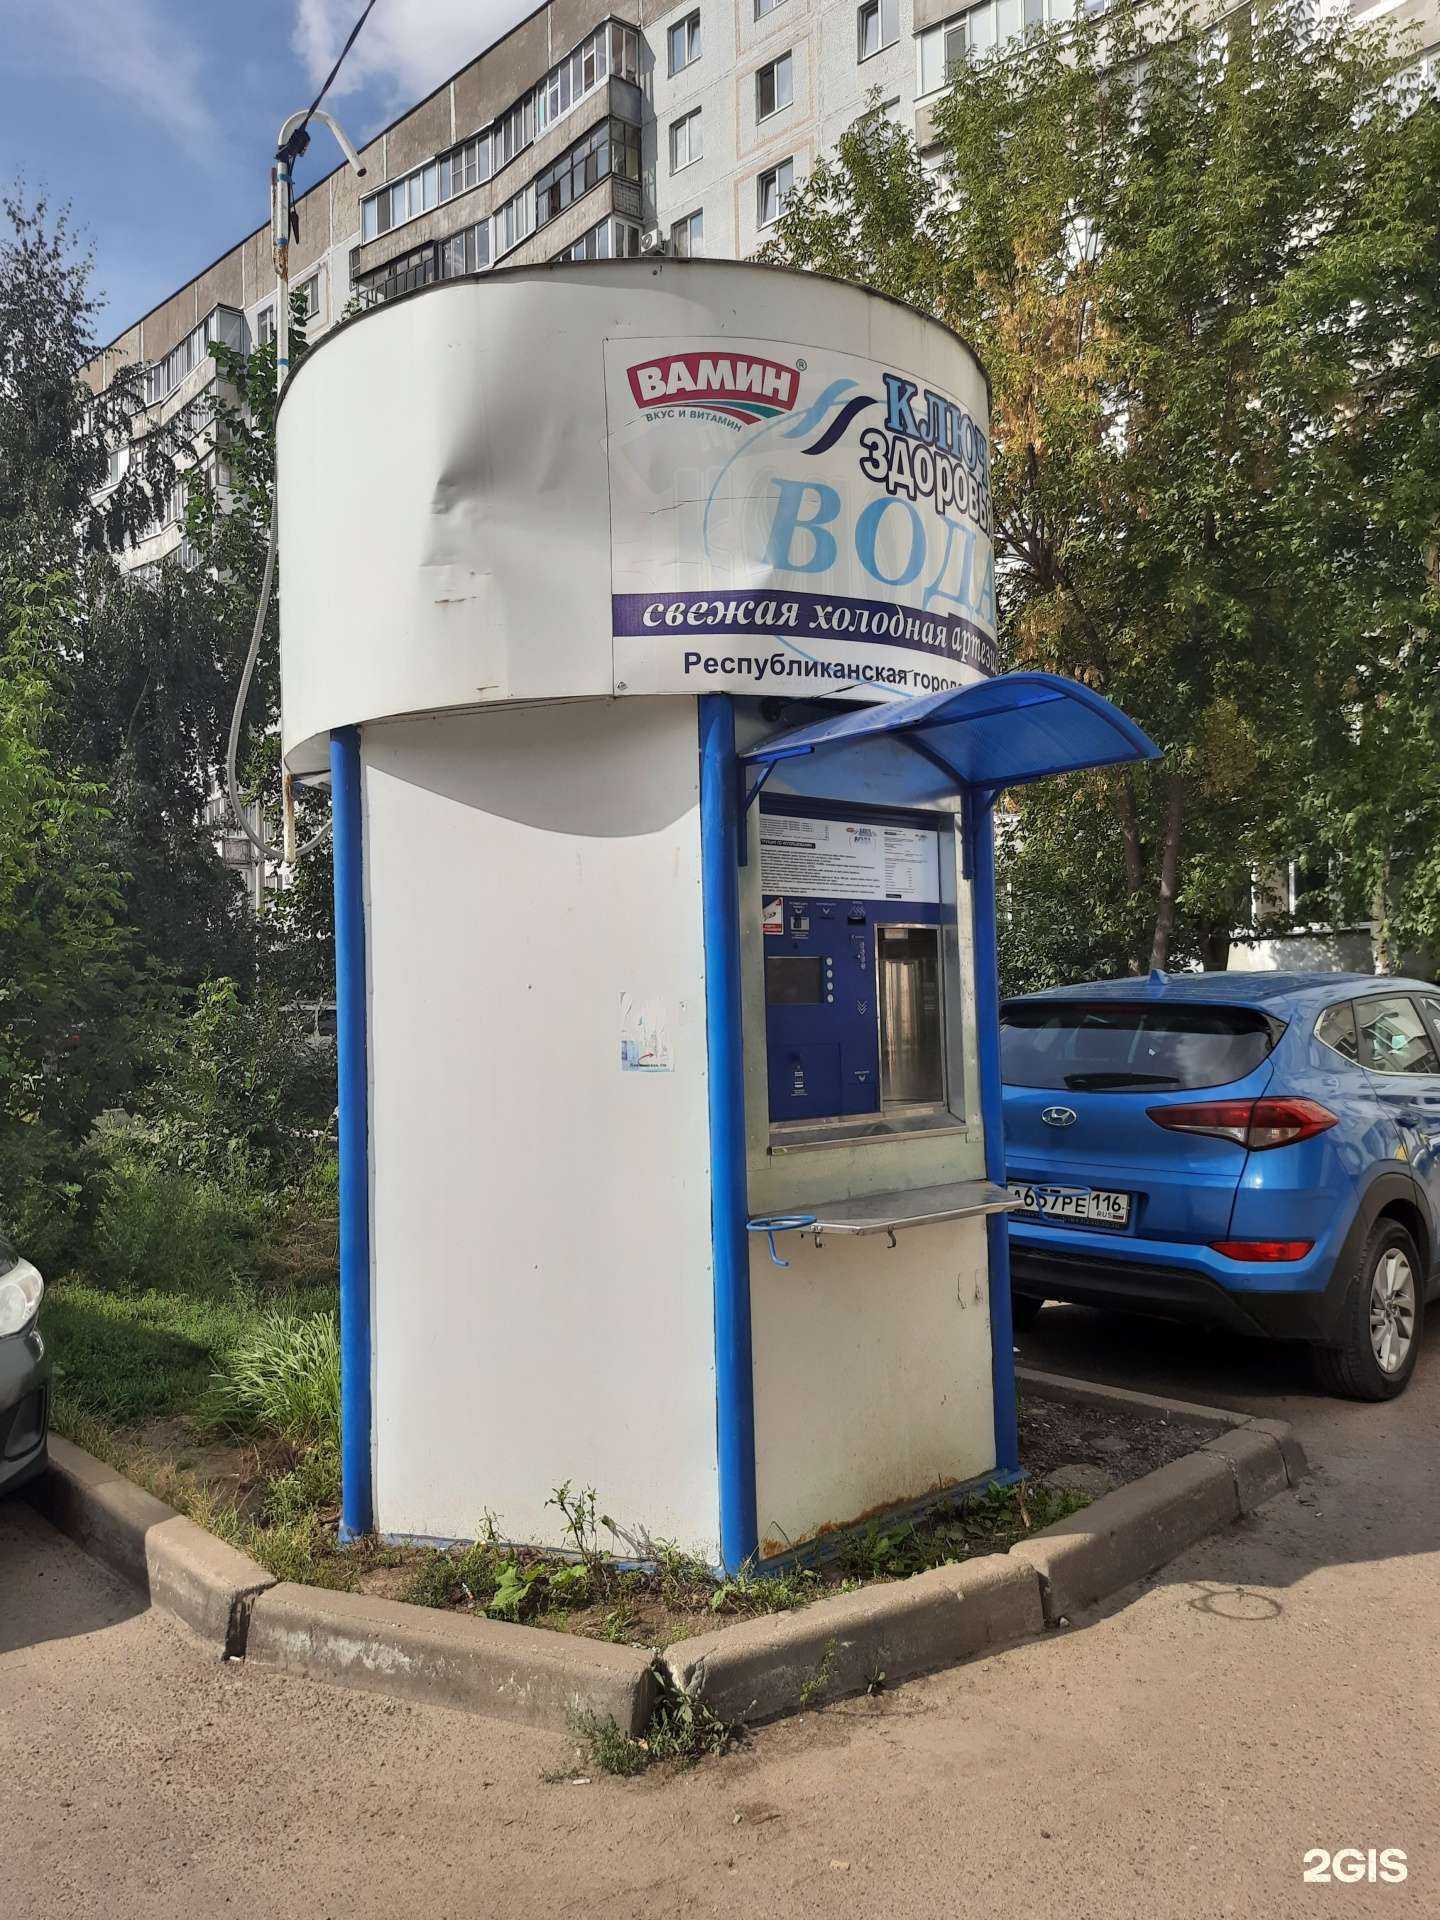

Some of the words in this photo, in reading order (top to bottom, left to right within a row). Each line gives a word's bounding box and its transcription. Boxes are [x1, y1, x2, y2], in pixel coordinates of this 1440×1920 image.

[636, 359, 791, 401] ВАМИН
[646, 409, 675, 422] ВКУС
[678, 410, 687, 418] И
[689, 410, 742, 432] ВИТАМИН
[764, 477, 995, 626] ВОДА
[642, 599, 799, 628] свежая
[809, 604, 948, 649] холодная
[683, 652, 907, 685] Республиканская
[914, 671, 963, 692] горо
[1092, 1193, 1122, 1213] 116
[1096, 1210, 1112, 1219] RUS
